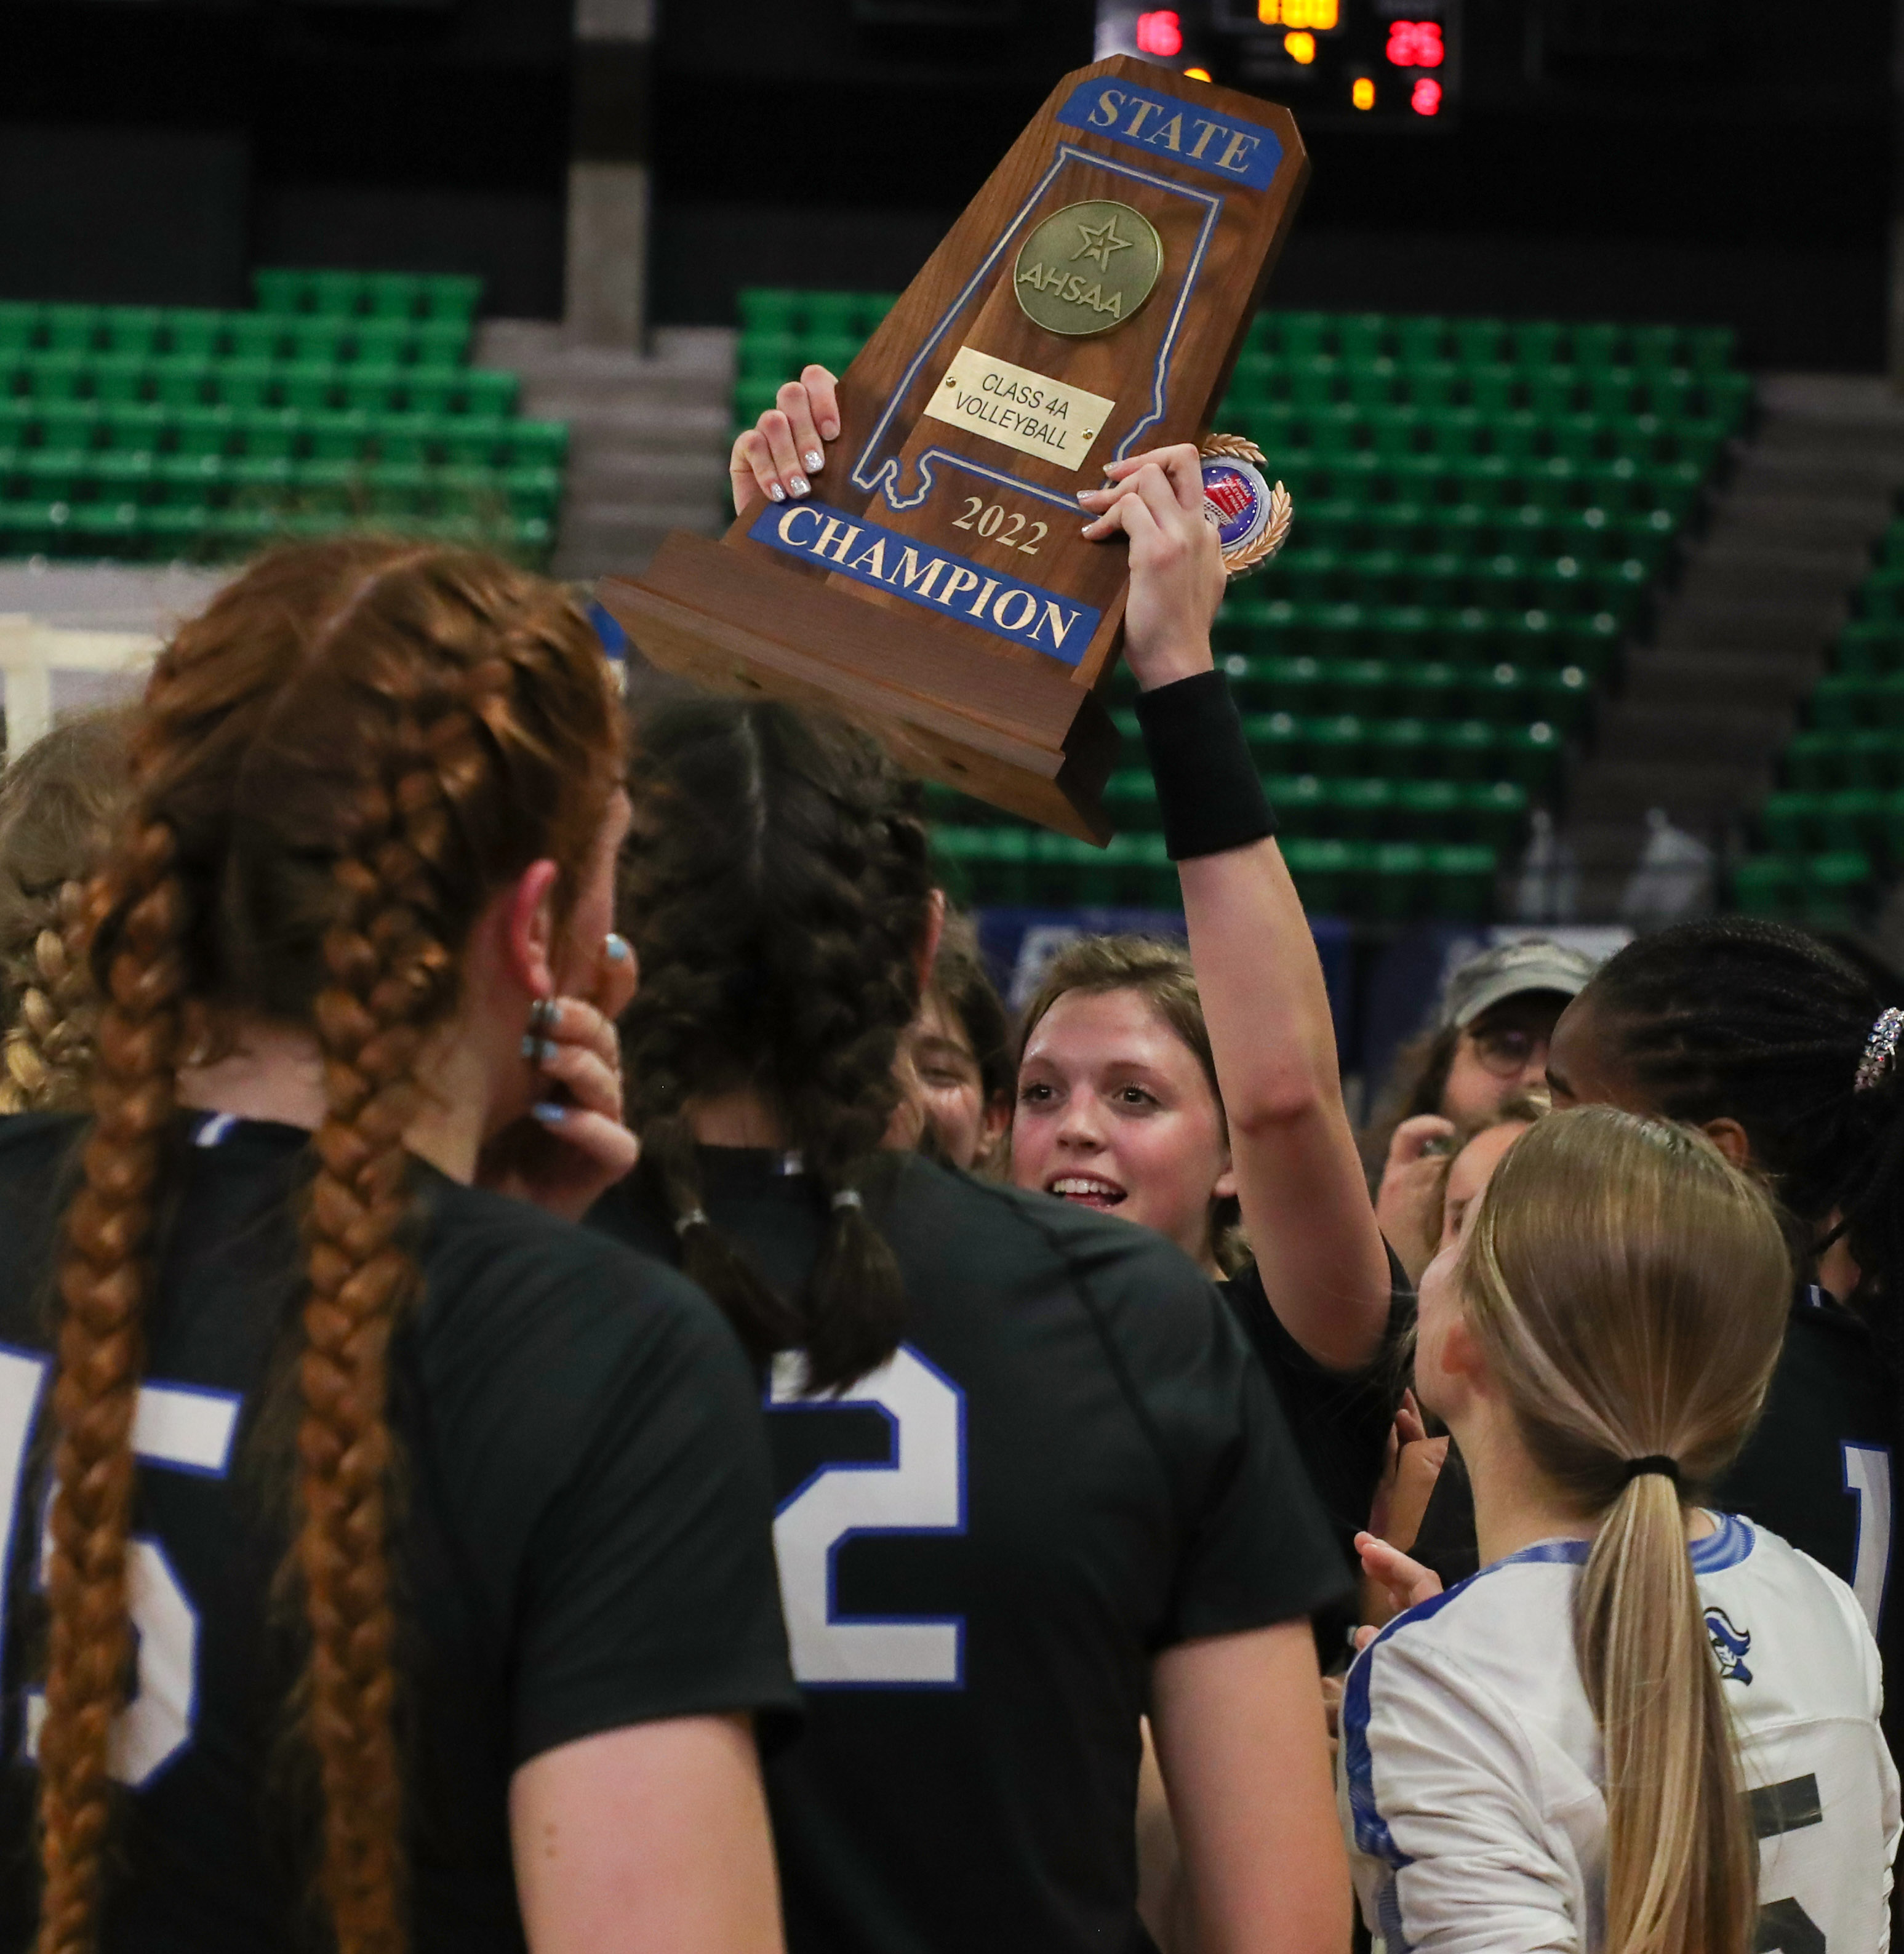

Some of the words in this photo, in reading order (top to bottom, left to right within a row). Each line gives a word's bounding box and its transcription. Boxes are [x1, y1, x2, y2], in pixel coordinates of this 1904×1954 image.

[1087, 89, 1260, 174] STATE
[1017, 262, 1121, 318] AHSAA
[956, 392, 1067, 449] VOLLEYBALL
[982, 374, 1044, 408] CLASS
[1046, 398, 1069, 420] 4A
[1234, 478, 1251, 499] AHSAA
[951, 497, 1048, 555] 2022
[778, 507, 1082, 649] CHAMPION
[763, 1340, 967, 1691] 2
